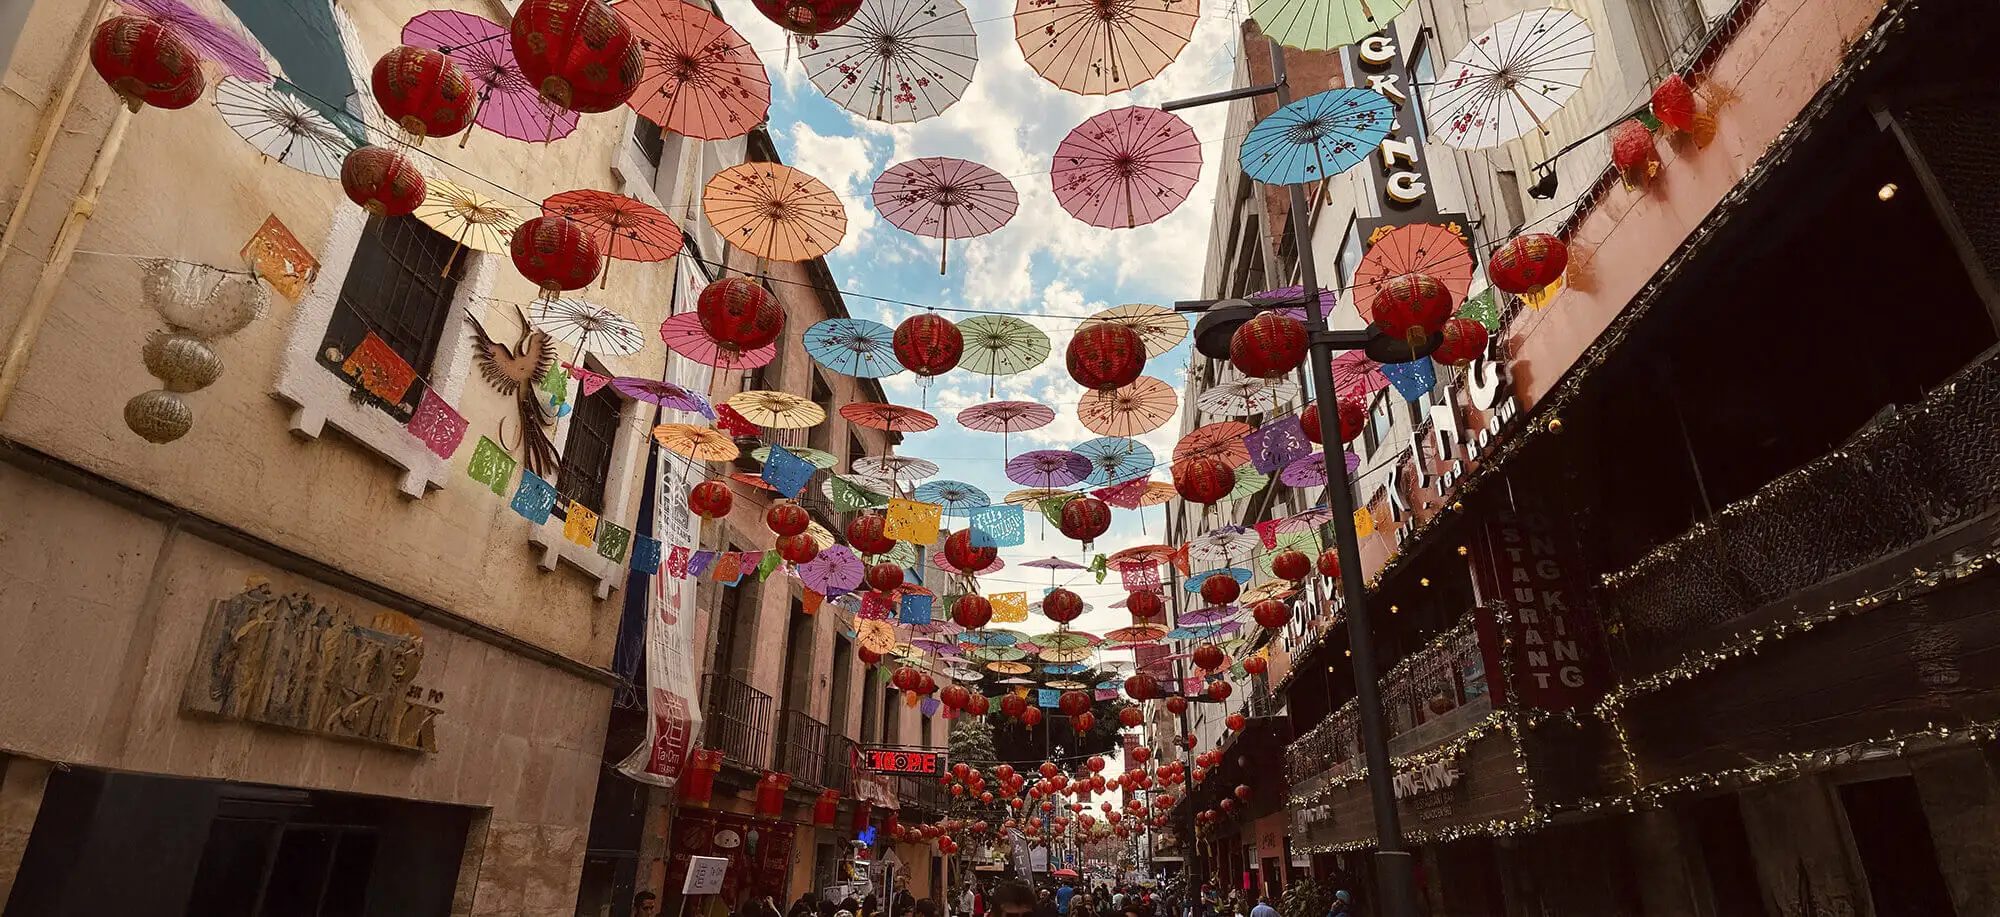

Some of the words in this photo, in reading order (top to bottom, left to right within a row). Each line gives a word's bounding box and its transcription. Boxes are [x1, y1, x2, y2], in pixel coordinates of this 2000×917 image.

[1366, 74, 1427, 204] KNG
[1435, 459, 1463, 497] Tea
[1466, 396, 1515, 461] Room
[1541, 590, 1585, 688] KING
